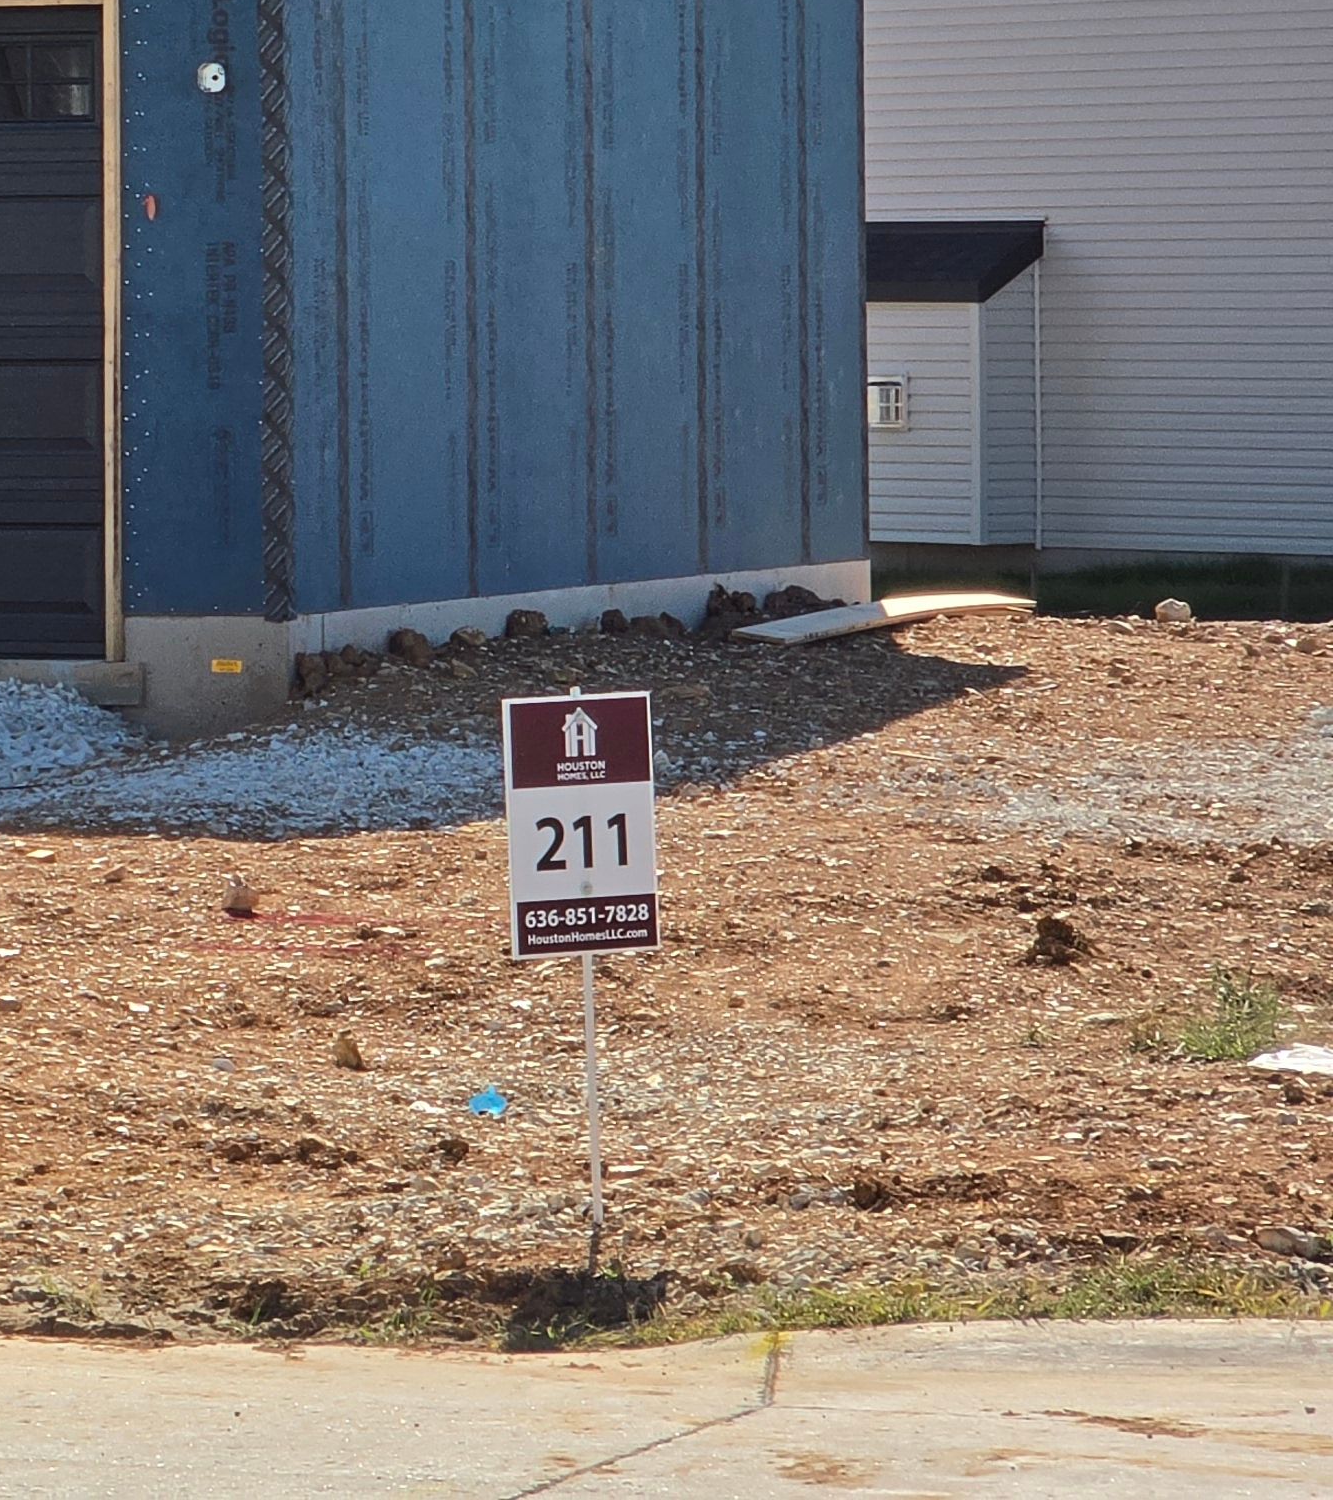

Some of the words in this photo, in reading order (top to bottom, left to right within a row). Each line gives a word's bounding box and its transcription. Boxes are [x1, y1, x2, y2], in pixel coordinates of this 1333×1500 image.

[556, 760, 605, 772] HOUSTON
[556, 771, 589, 781] HOMES,
[590, 770, 606, 780] LLC
[535, 813, 628, 872] 211
[525, 903, 650, 929] 636-851-7828
[527, 927, 648, 946] HoustonHomesLLC.com
